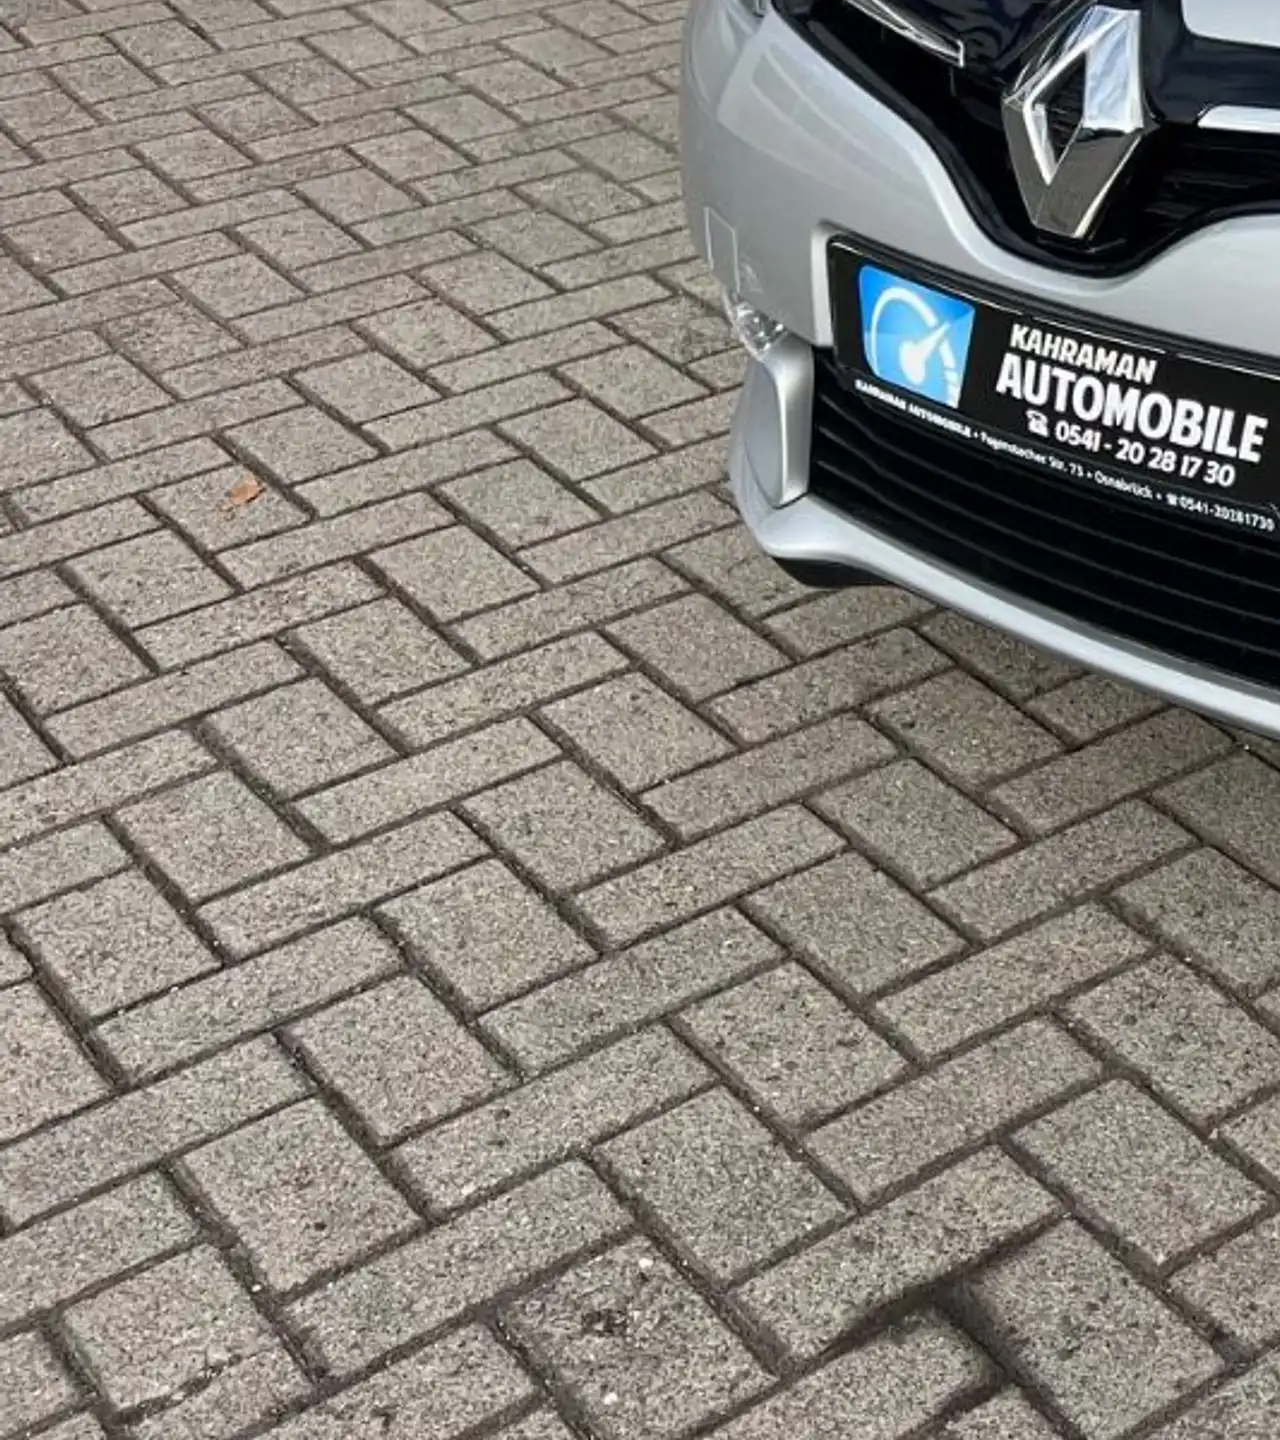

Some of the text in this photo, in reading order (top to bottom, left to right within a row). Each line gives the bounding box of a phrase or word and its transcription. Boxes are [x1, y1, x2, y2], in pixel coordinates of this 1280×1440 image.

[1010, 323, 1157, 385] KAHRAMAN
[996, 351, 1269, 463] AUTOMOBILE
[1055, 420, 1102, 453] 0541
[1115, 438, 1146, 465] 20
[1148, 446, 1177, 473] 28
[1179, 454, 1204, 479] 17
[1203, 460, 1237, 487] 30
[1094, 470, 1153, 500] Osnabrück
